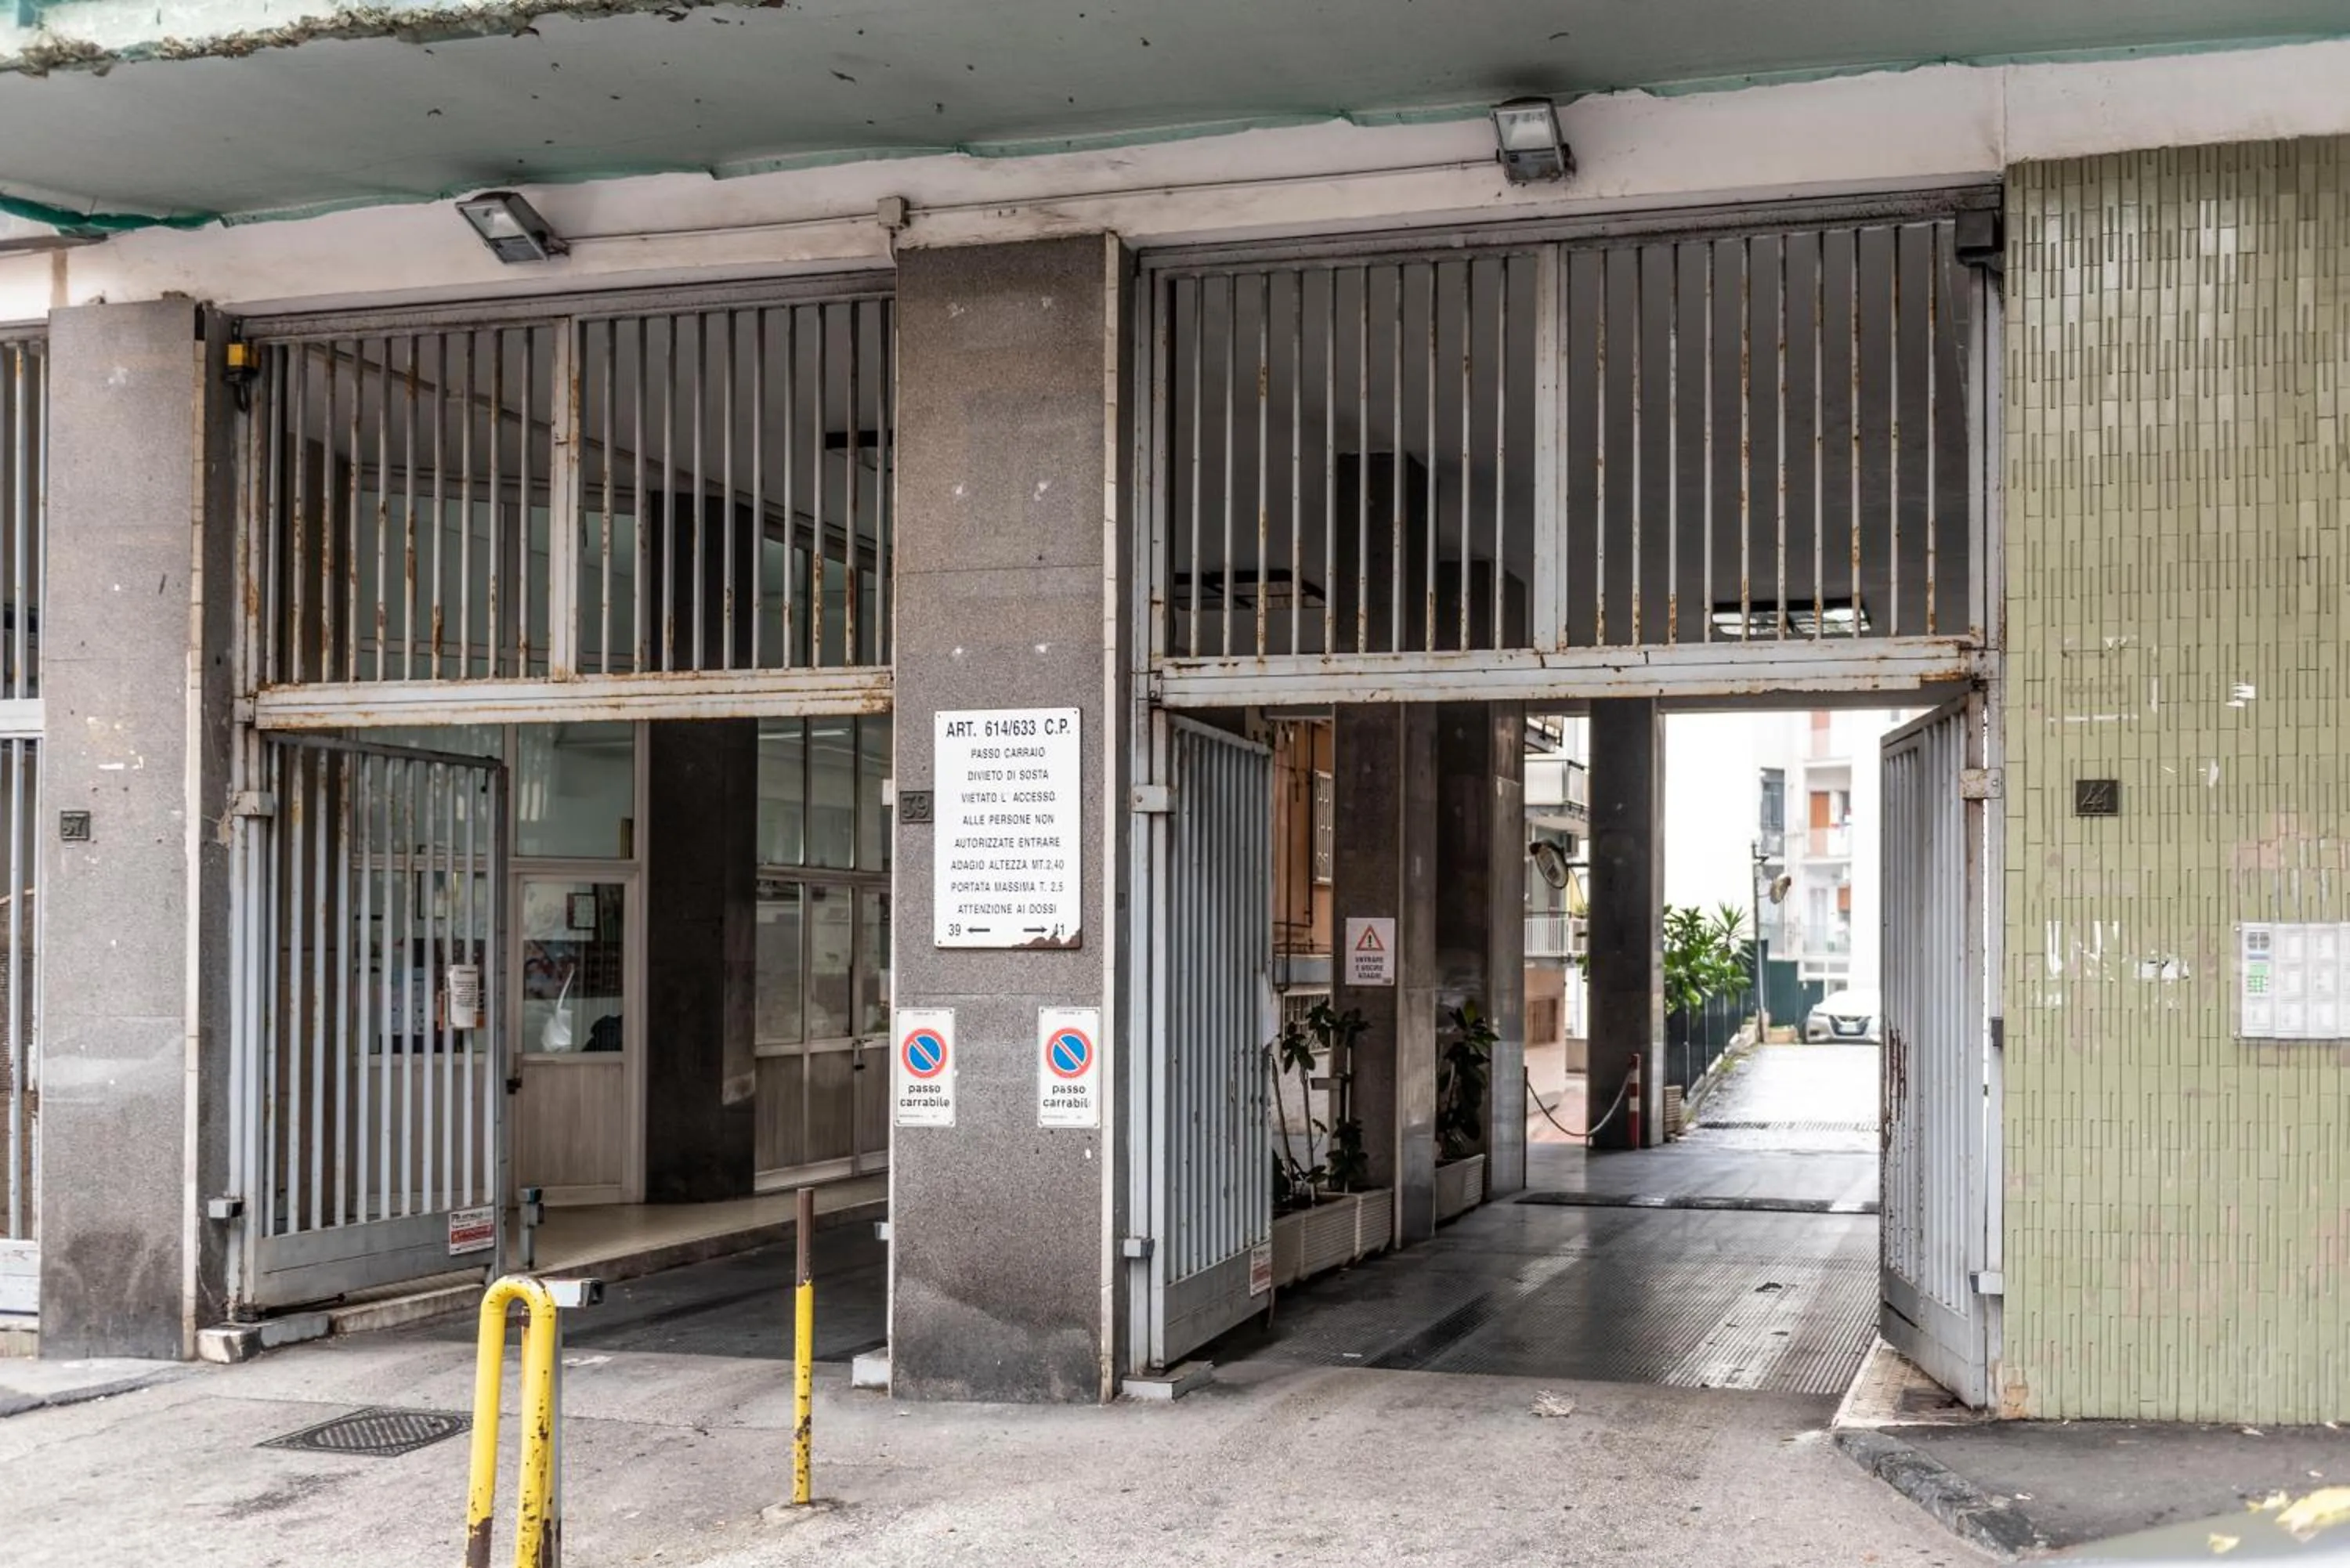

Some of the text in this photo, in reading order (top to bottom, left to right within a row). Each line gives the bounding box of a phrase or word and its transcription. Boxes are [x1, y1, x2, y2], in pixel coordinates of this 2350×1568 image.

[946, 717, 1071, 738] ART. 614/633 C.P.
[971, 746, 1046, 759] PASSO CARRAIO
[967, 769, 1049, 781] DIVIETO DI SOSTA
[961, 793, 997, 803] VIETATO
[1013, 791, 1055, 802] ACCESSO
[902, 794, 928, 819] 39
[62, 815, 86, 836] 37
[963, 814, 1054, 826] ALLE PERSONE NON
[955, 836, 1060, 848] AUTORIZZATE ENTRARE
[951, 860, 985, 870] ADAGIO
[989, 860, 1028, 870] ALTEZZA
[951, 882, 990, 892] PORTATA
[994, 881, 1035, 892] MASSIMA
[1039, 881, 1047, 892] T.
[957, 904, 1057, 914] ATTENZIONE AI DOSSI
[948, 923, 961, 937] 39
[907, 1085, 941, 1095] passo
[1052, 1085, 1086, 1095] passo
[900, 1097, 950, 1107] carrabile
